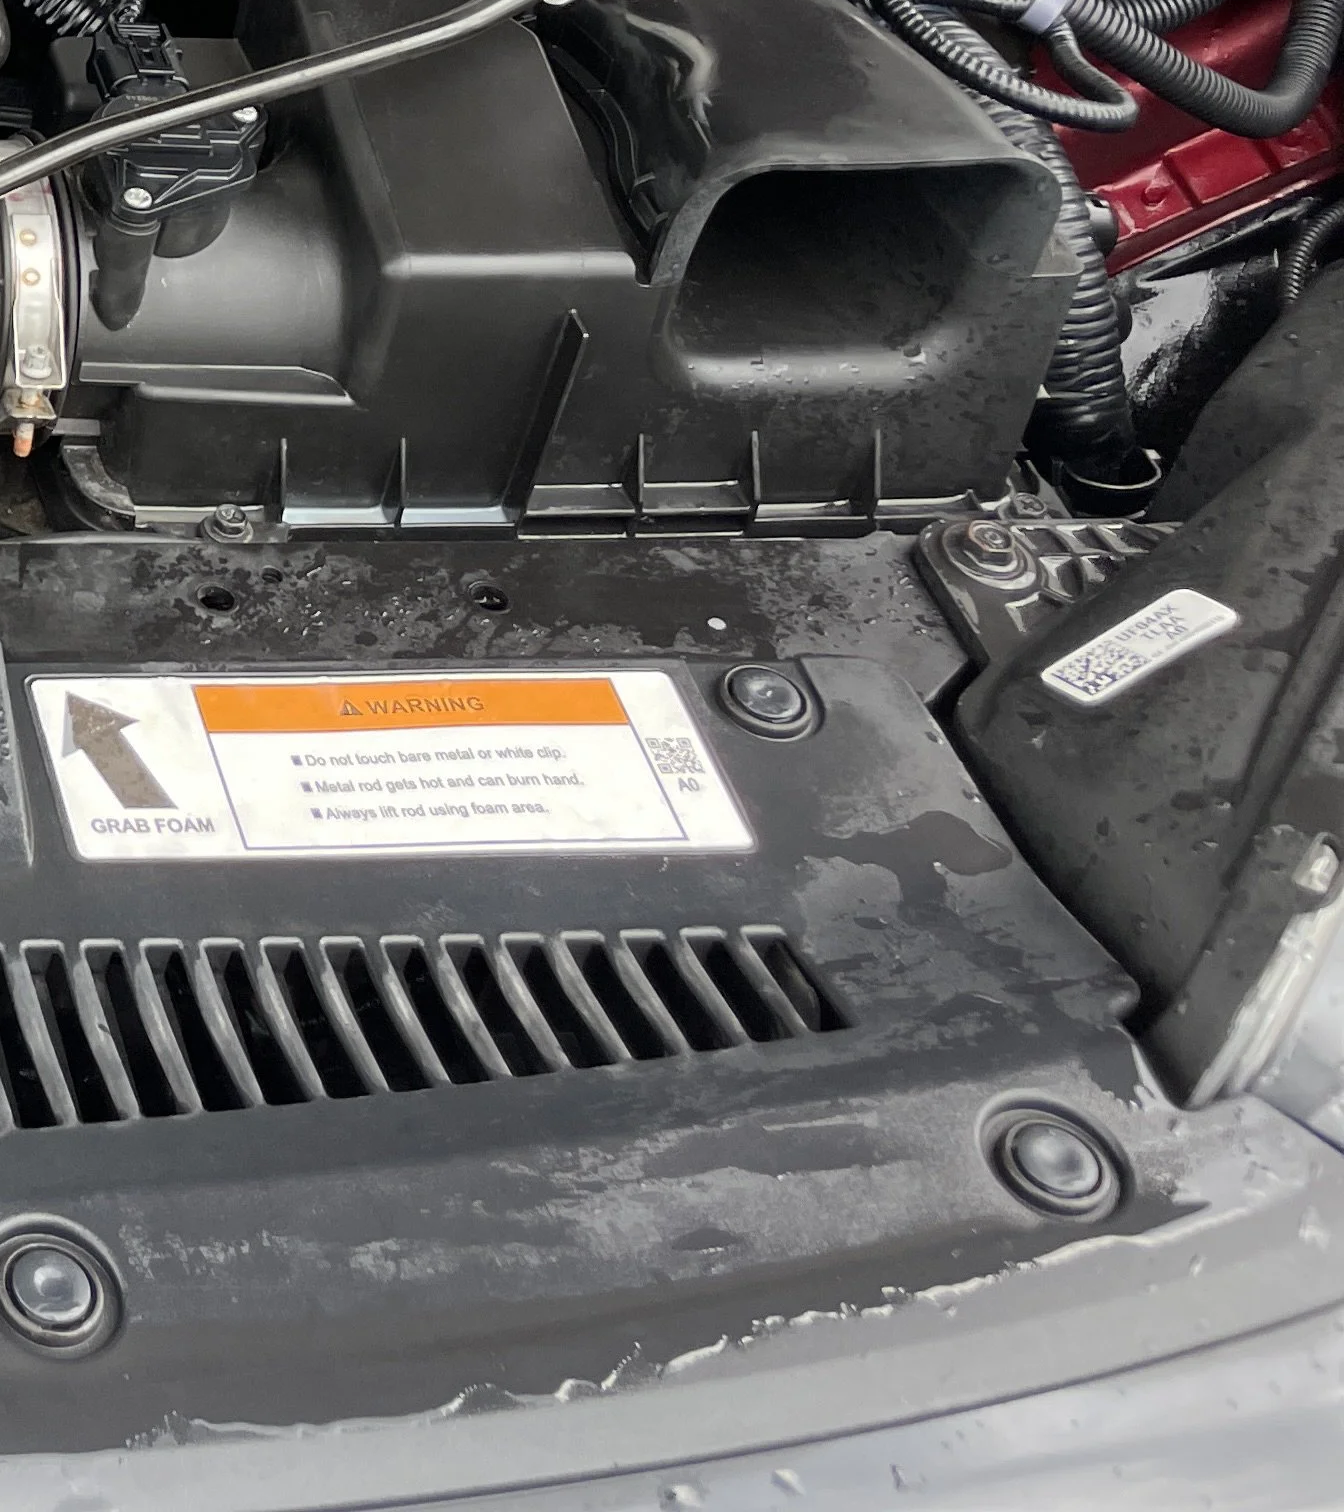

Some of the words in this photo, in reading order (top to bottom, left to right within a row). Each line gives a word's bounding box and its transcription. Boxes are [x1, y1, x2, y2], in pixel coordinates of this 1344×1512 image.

[365, 696, 485, 714] WARNING
[305, 754, 327, 766] Do
[330, 753, 354, 766] not
[355, 751, 396, 765] touch
[398, 750, 432, 764] bare
[435, 748, 475, 761] metal
[477, 749, 492, 760] or
[494, 747, 534, 759] white
[537, 746, 567, 761] clip.
[315, 780, 355, 793] Metal
[358, 779, 383, 791] rod
[386, 778, 417, 793] gets
[419, 776, 445, 789] hot
[447, 774, 475, 788] and
[477, 776, 505, 787] can
[506, 773, 541, 786] burn
[542, 772, 585, 786] hand.
[326, 807, 377, 821] Always
[379, 805, 399, 818] lift
[401, 804, 425, 817] rod
[429, 802, 470, 818] using
[471, 801, 509, 814] foam
[511, 802, 550, 814] area.
[91, 817, 151, 834] GRAB
[154, 817, 216, 834] FOAM
